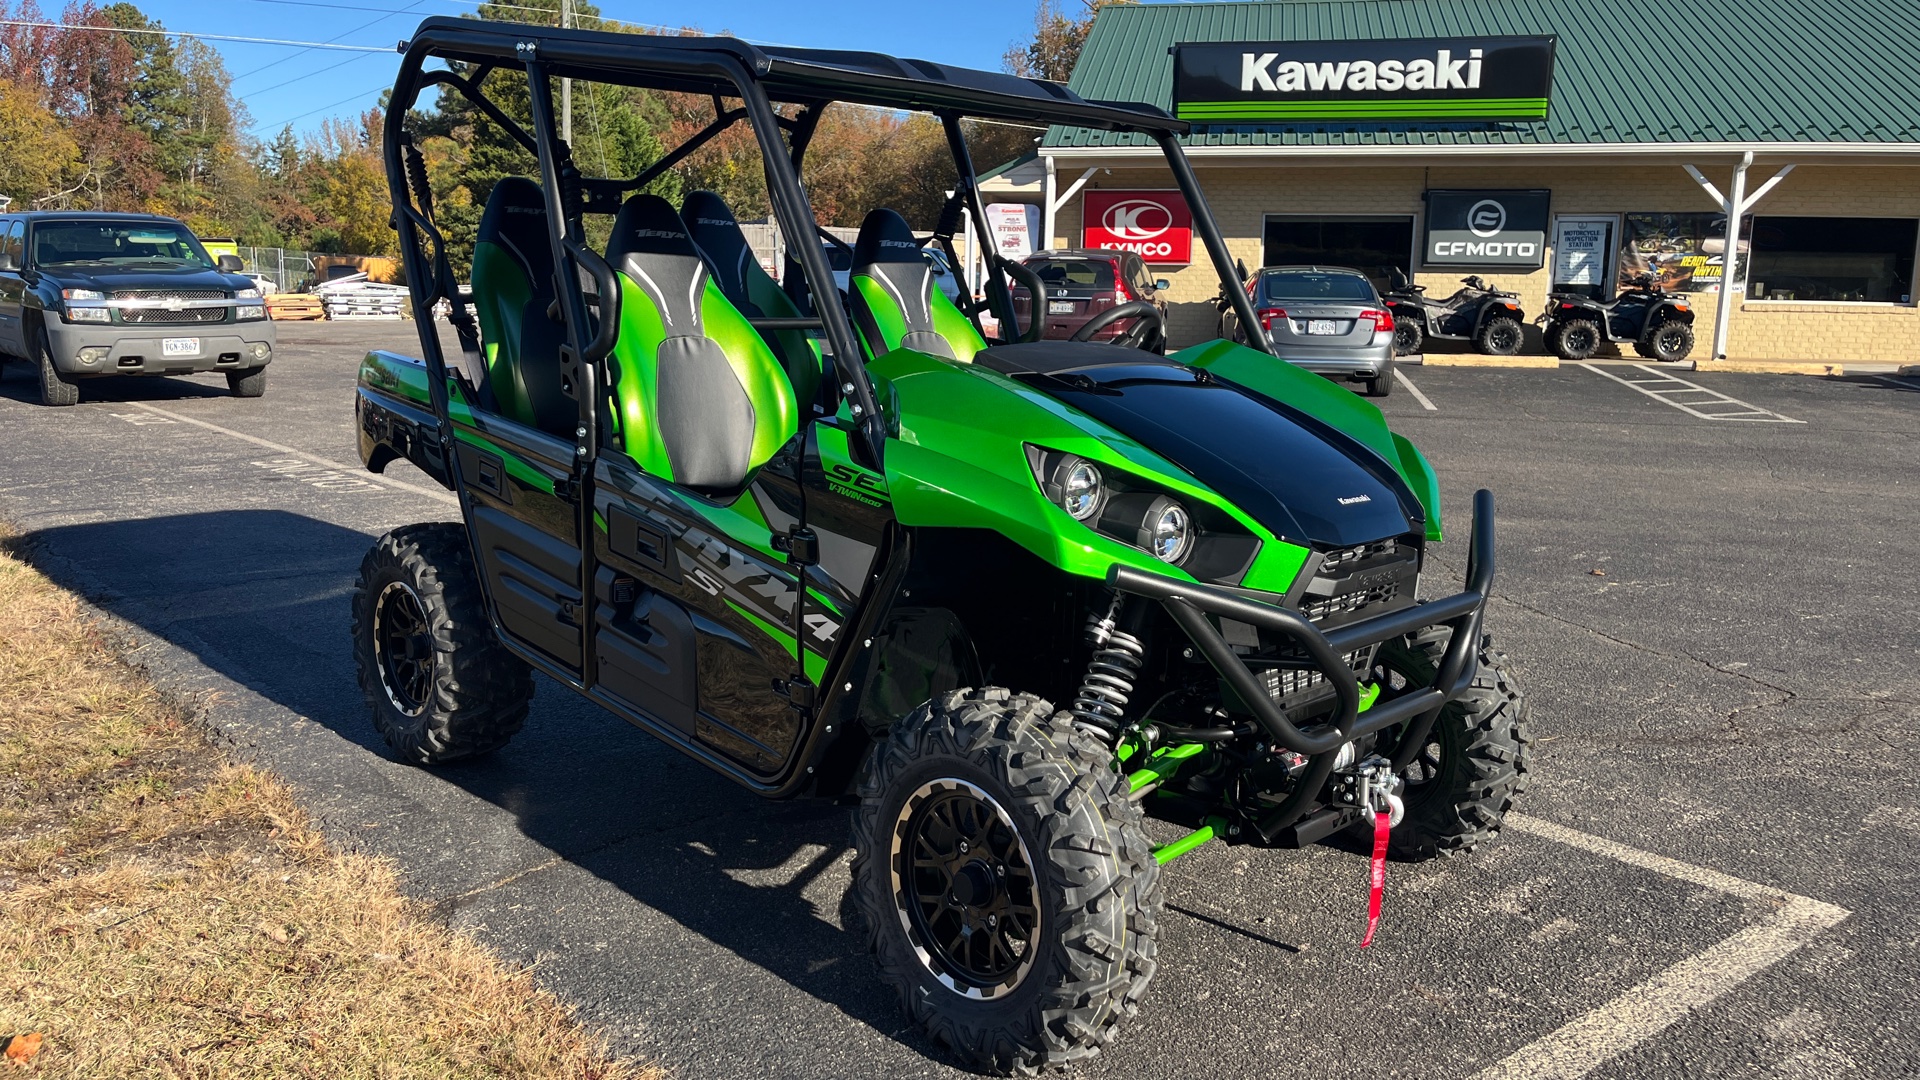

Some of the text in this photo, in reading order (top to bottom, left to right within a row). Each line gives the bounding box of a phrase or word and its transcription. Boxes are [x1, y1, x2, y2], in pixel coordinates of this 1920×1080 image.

[1240, 48, 1483, 92] Kawasaki
[1434, 242, 1535, 257] CFMOTO
[1680, 255, 1709, 267] READY
[1692, 266, 1722, 277] ANYTH
[832, 464, 884, 490] SE
[1337, 494, 1372, 506] Kawasaki
[1372, 857, 1385, 890] WARN
